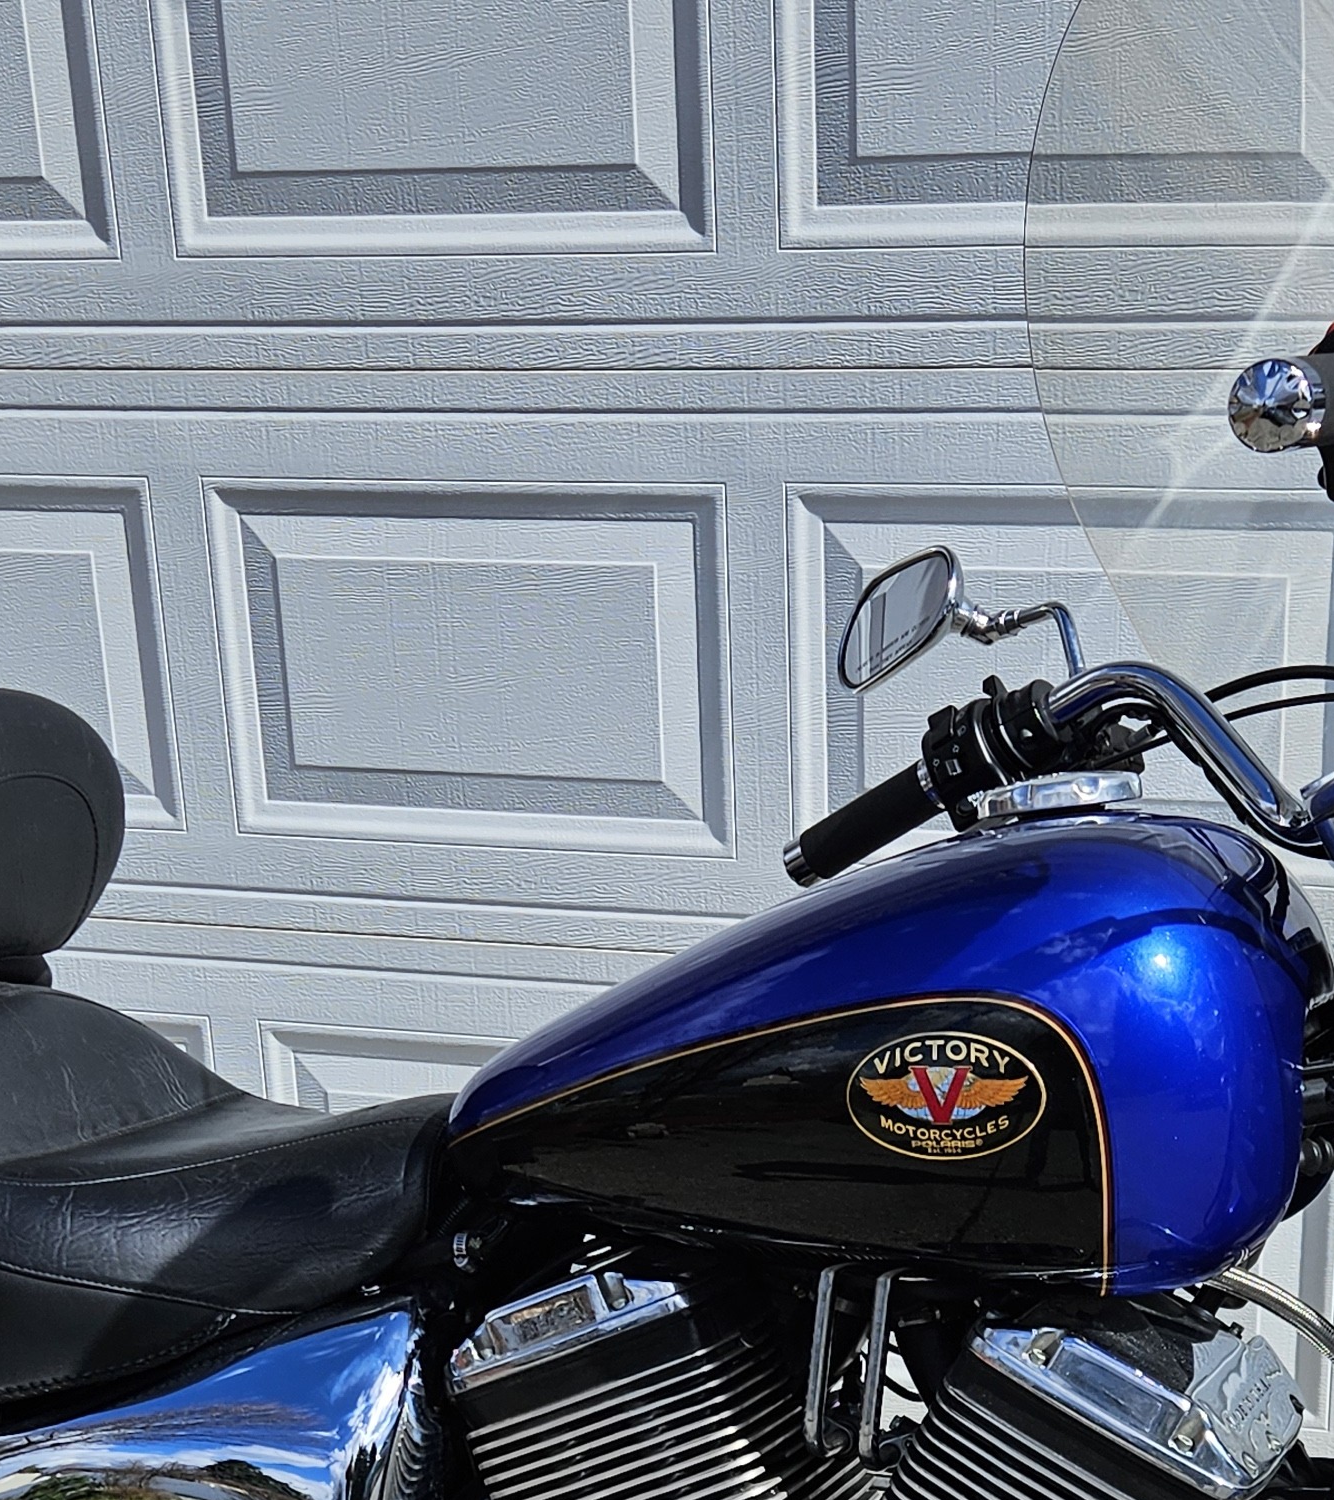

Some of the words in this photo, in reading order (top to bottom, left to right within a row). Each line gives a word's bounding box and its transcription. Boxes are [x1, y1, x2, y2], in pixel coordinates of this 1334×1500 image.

[873, 1039, 1010, 1074] VICTORY
[908, 1065, 973, 1125] V
[879, 1114, 1010, 1141] MOTORCYCLES
